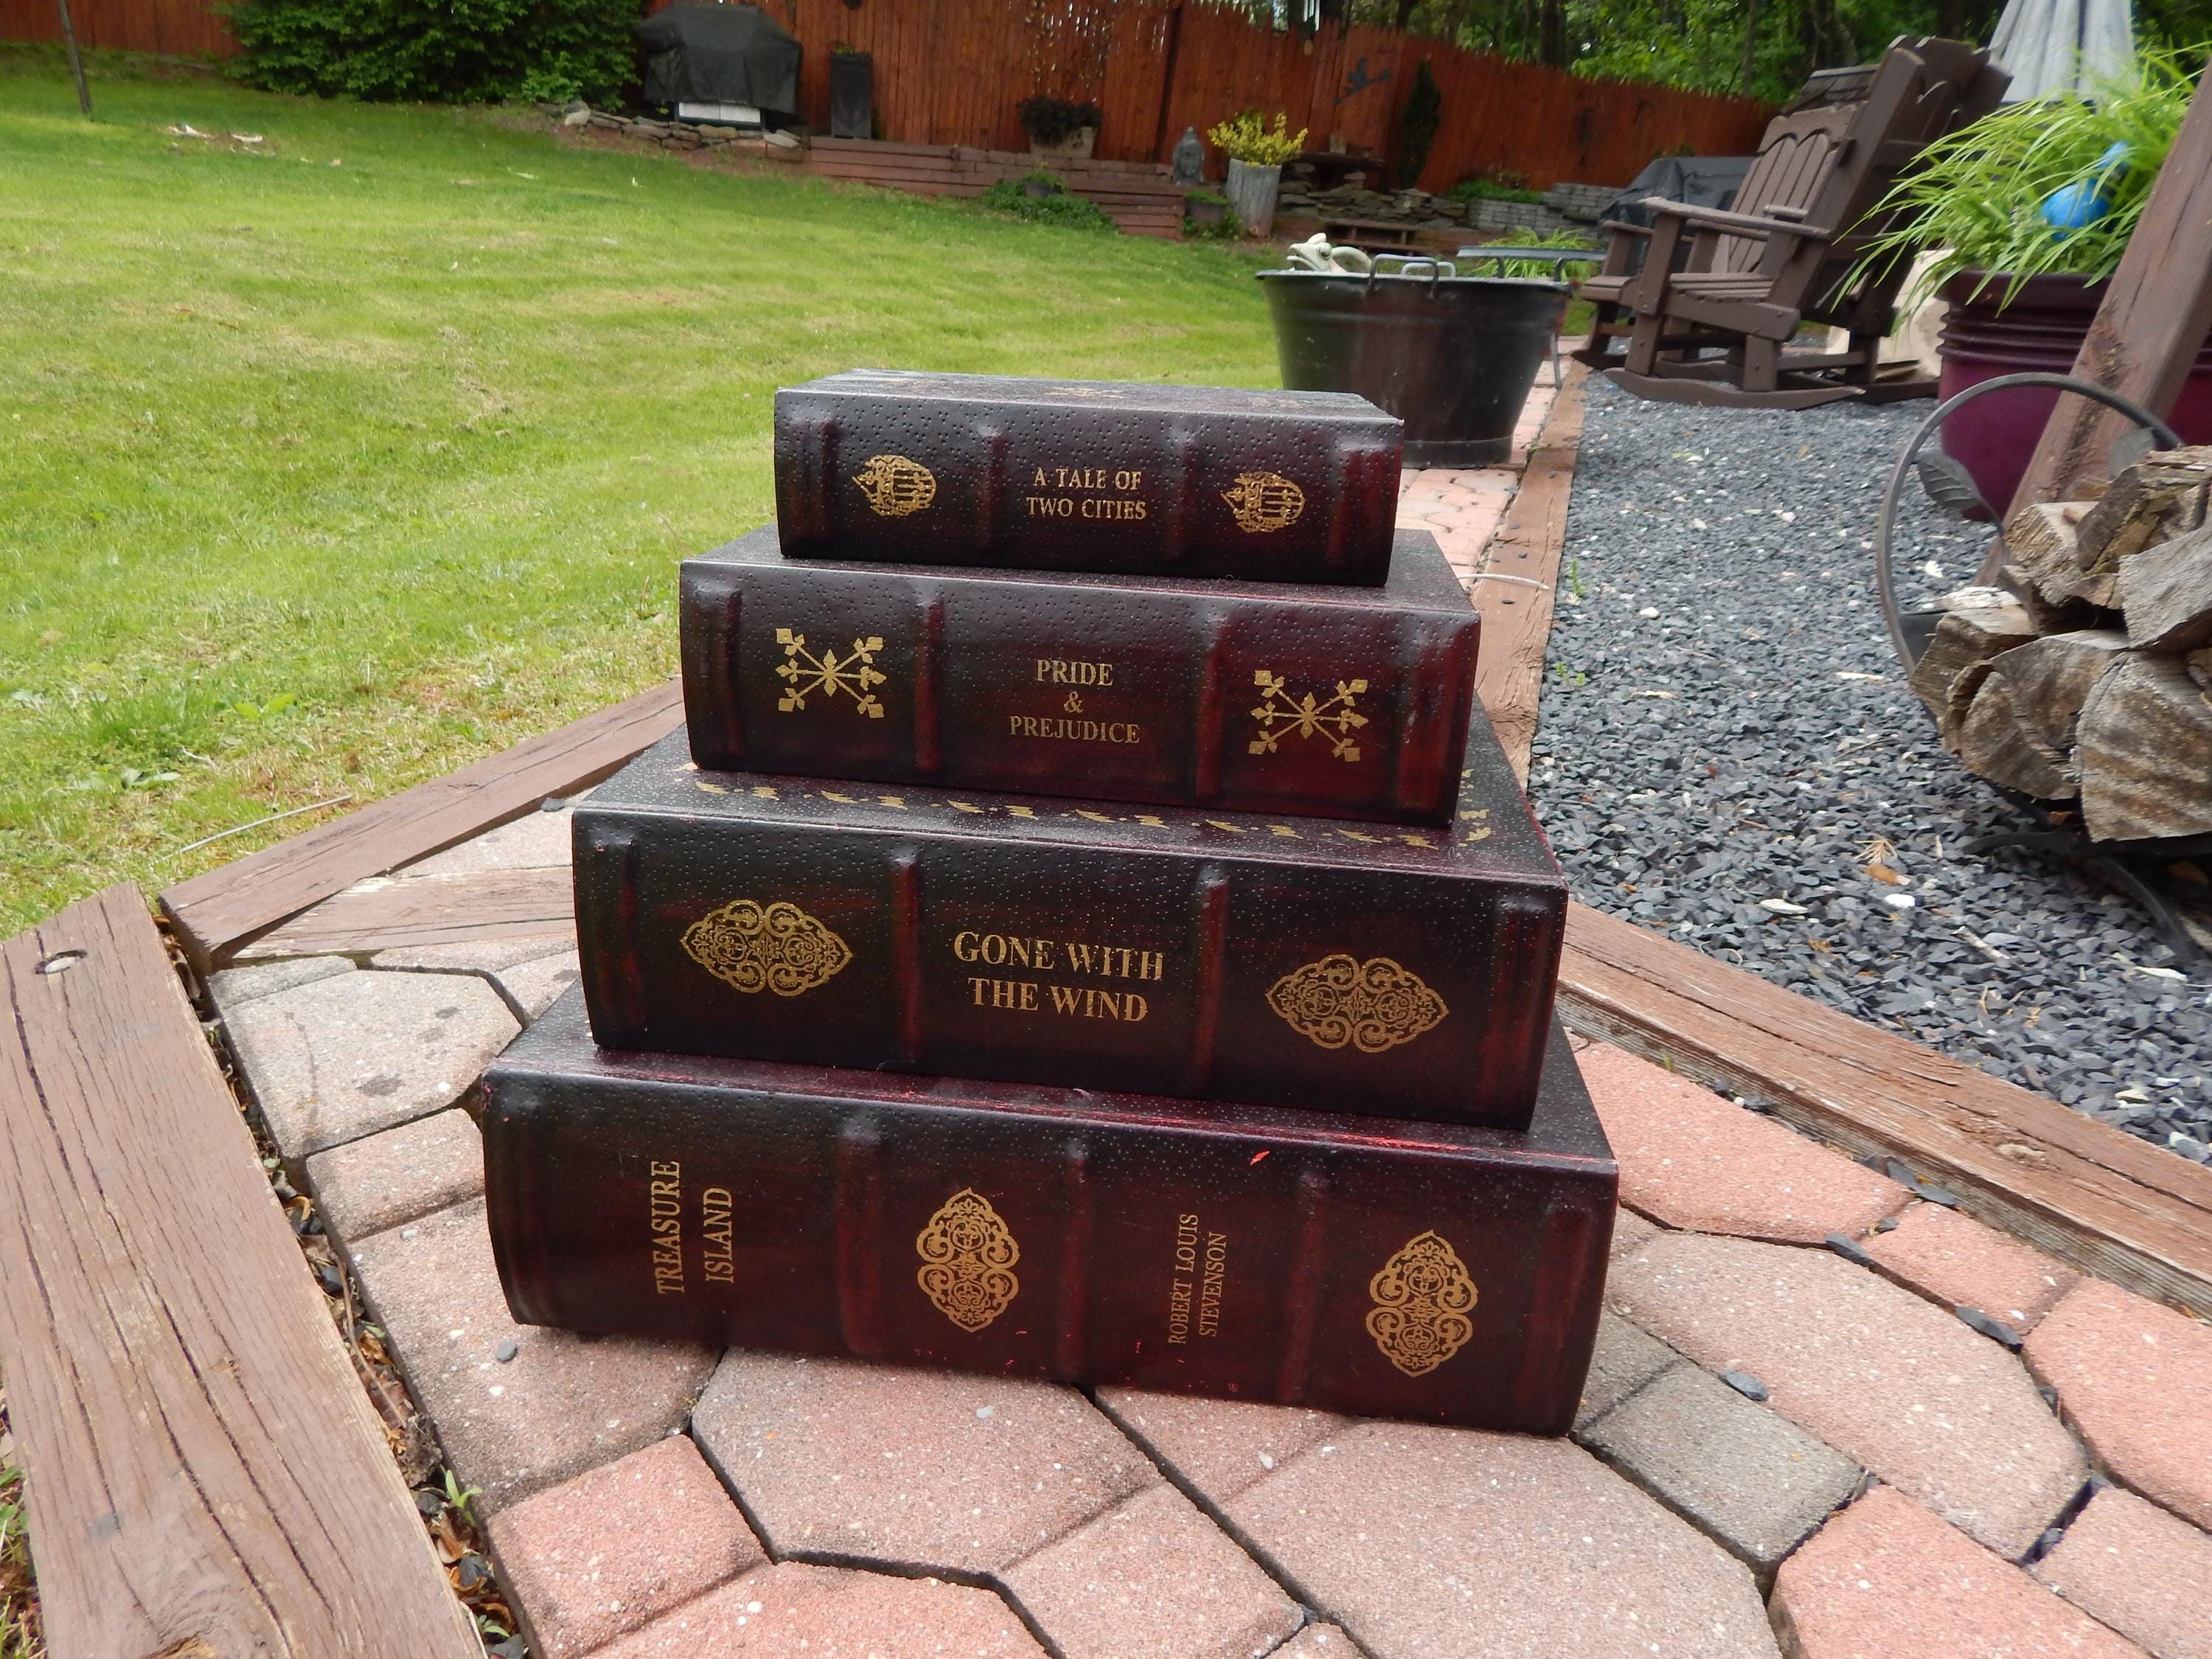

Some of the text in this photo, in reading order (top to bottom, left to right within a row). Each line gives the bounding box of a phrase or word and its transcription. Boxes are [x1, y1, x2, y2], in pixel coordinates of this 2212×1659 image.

[1034, 467, 1141, 490] A TALE OF
[1026, 497, 1147, 520] TWO CITIES
[1037, 659, 1113, 686] PRIDE
[1063, 690, 1084, 713] &
[1009, 716, 1140, 743] PREJUDICE
[954, 931, 1163, 981] GONE WITH
[968, 977, 1148, 1022] THE WIND
[650, 1161, 684, 1294] TREASURE
[703, 1188, 734, 1284] ISLAND
[1168, 1214, 1199, 1344] ROBERT LOUIS
[1199, 1231, 1227, 1337] STEVENSON
